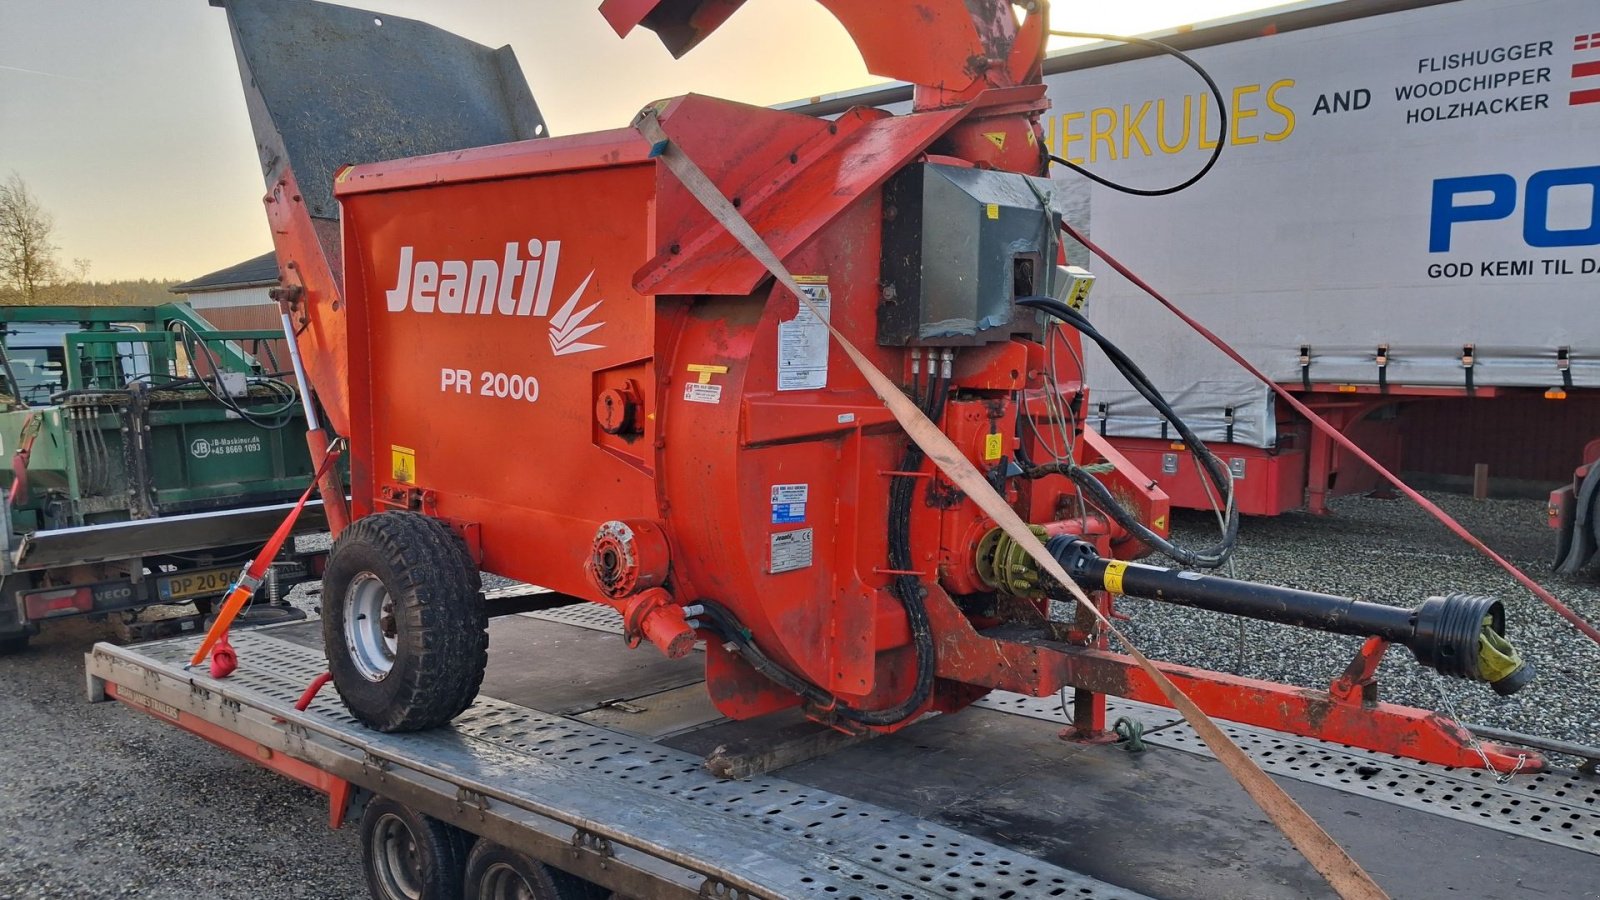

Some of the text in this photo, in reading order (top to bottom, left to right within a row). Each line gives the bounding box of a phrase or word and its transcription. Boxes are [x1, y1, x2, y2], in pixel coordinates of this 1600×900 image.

[1418, 40, 1553, 73] FLISHUGGER
[1395, 67, 1551, 101] WOODCHIPPER
[1312, 88, 1371, 115] AND
[1406, 94, 1549, 124] HOLZHACKER
[385, 238, 561, 317] Jeantil
[1427, 258, 1600, 279] GOD KEMI TIL D
[440, 368, 539, 402] PR 2000
[193, 442, 208, 454] JB
[211, 443, 260, 455] +45 8669 1093
[170, 578, 192, 595] DP
[197, 574, 216, 590] 20
[219, 570, 241, 586] 96
